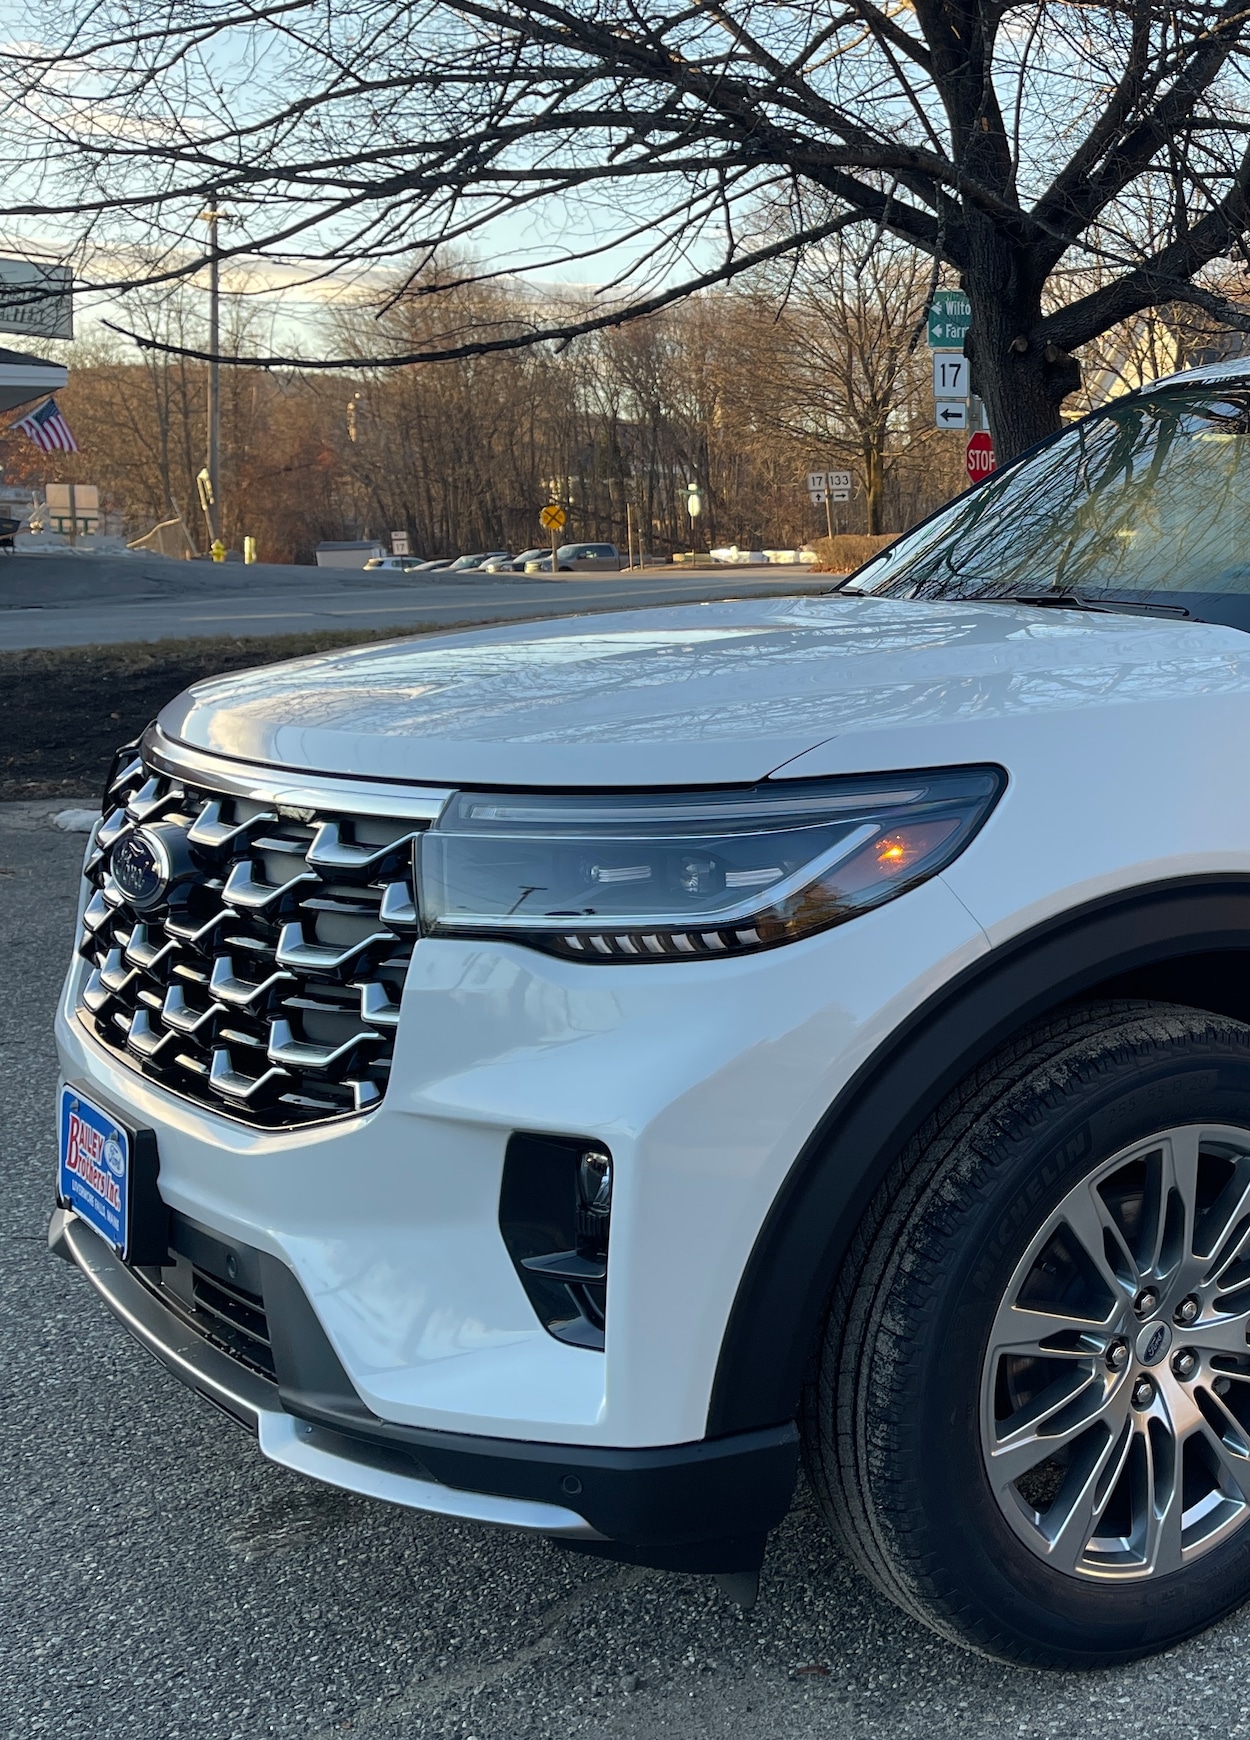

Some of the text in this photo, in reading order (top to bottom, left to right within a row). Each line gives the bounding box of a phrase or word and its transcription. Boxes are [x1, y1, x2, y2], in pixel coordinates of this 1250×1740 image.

[940, 363, 962, 387] 17
[967, 449, 996, 471] STOP
[811, 476, 823, 486] 17
[830, 475, 849, 486] 133
[1108, 1096, 1136, 1125] 255
[1147, 1085, 1165, 1104] 55
[1171, 1079, 1183, 1095] R
[66, 1113, 105, 1170] BAILEY
[104, 1172, 121, 1212] Inc.
[972, 1131, 1086, 1292] MICHELIN
[1149, 1333, 1162, 1356] Ford
